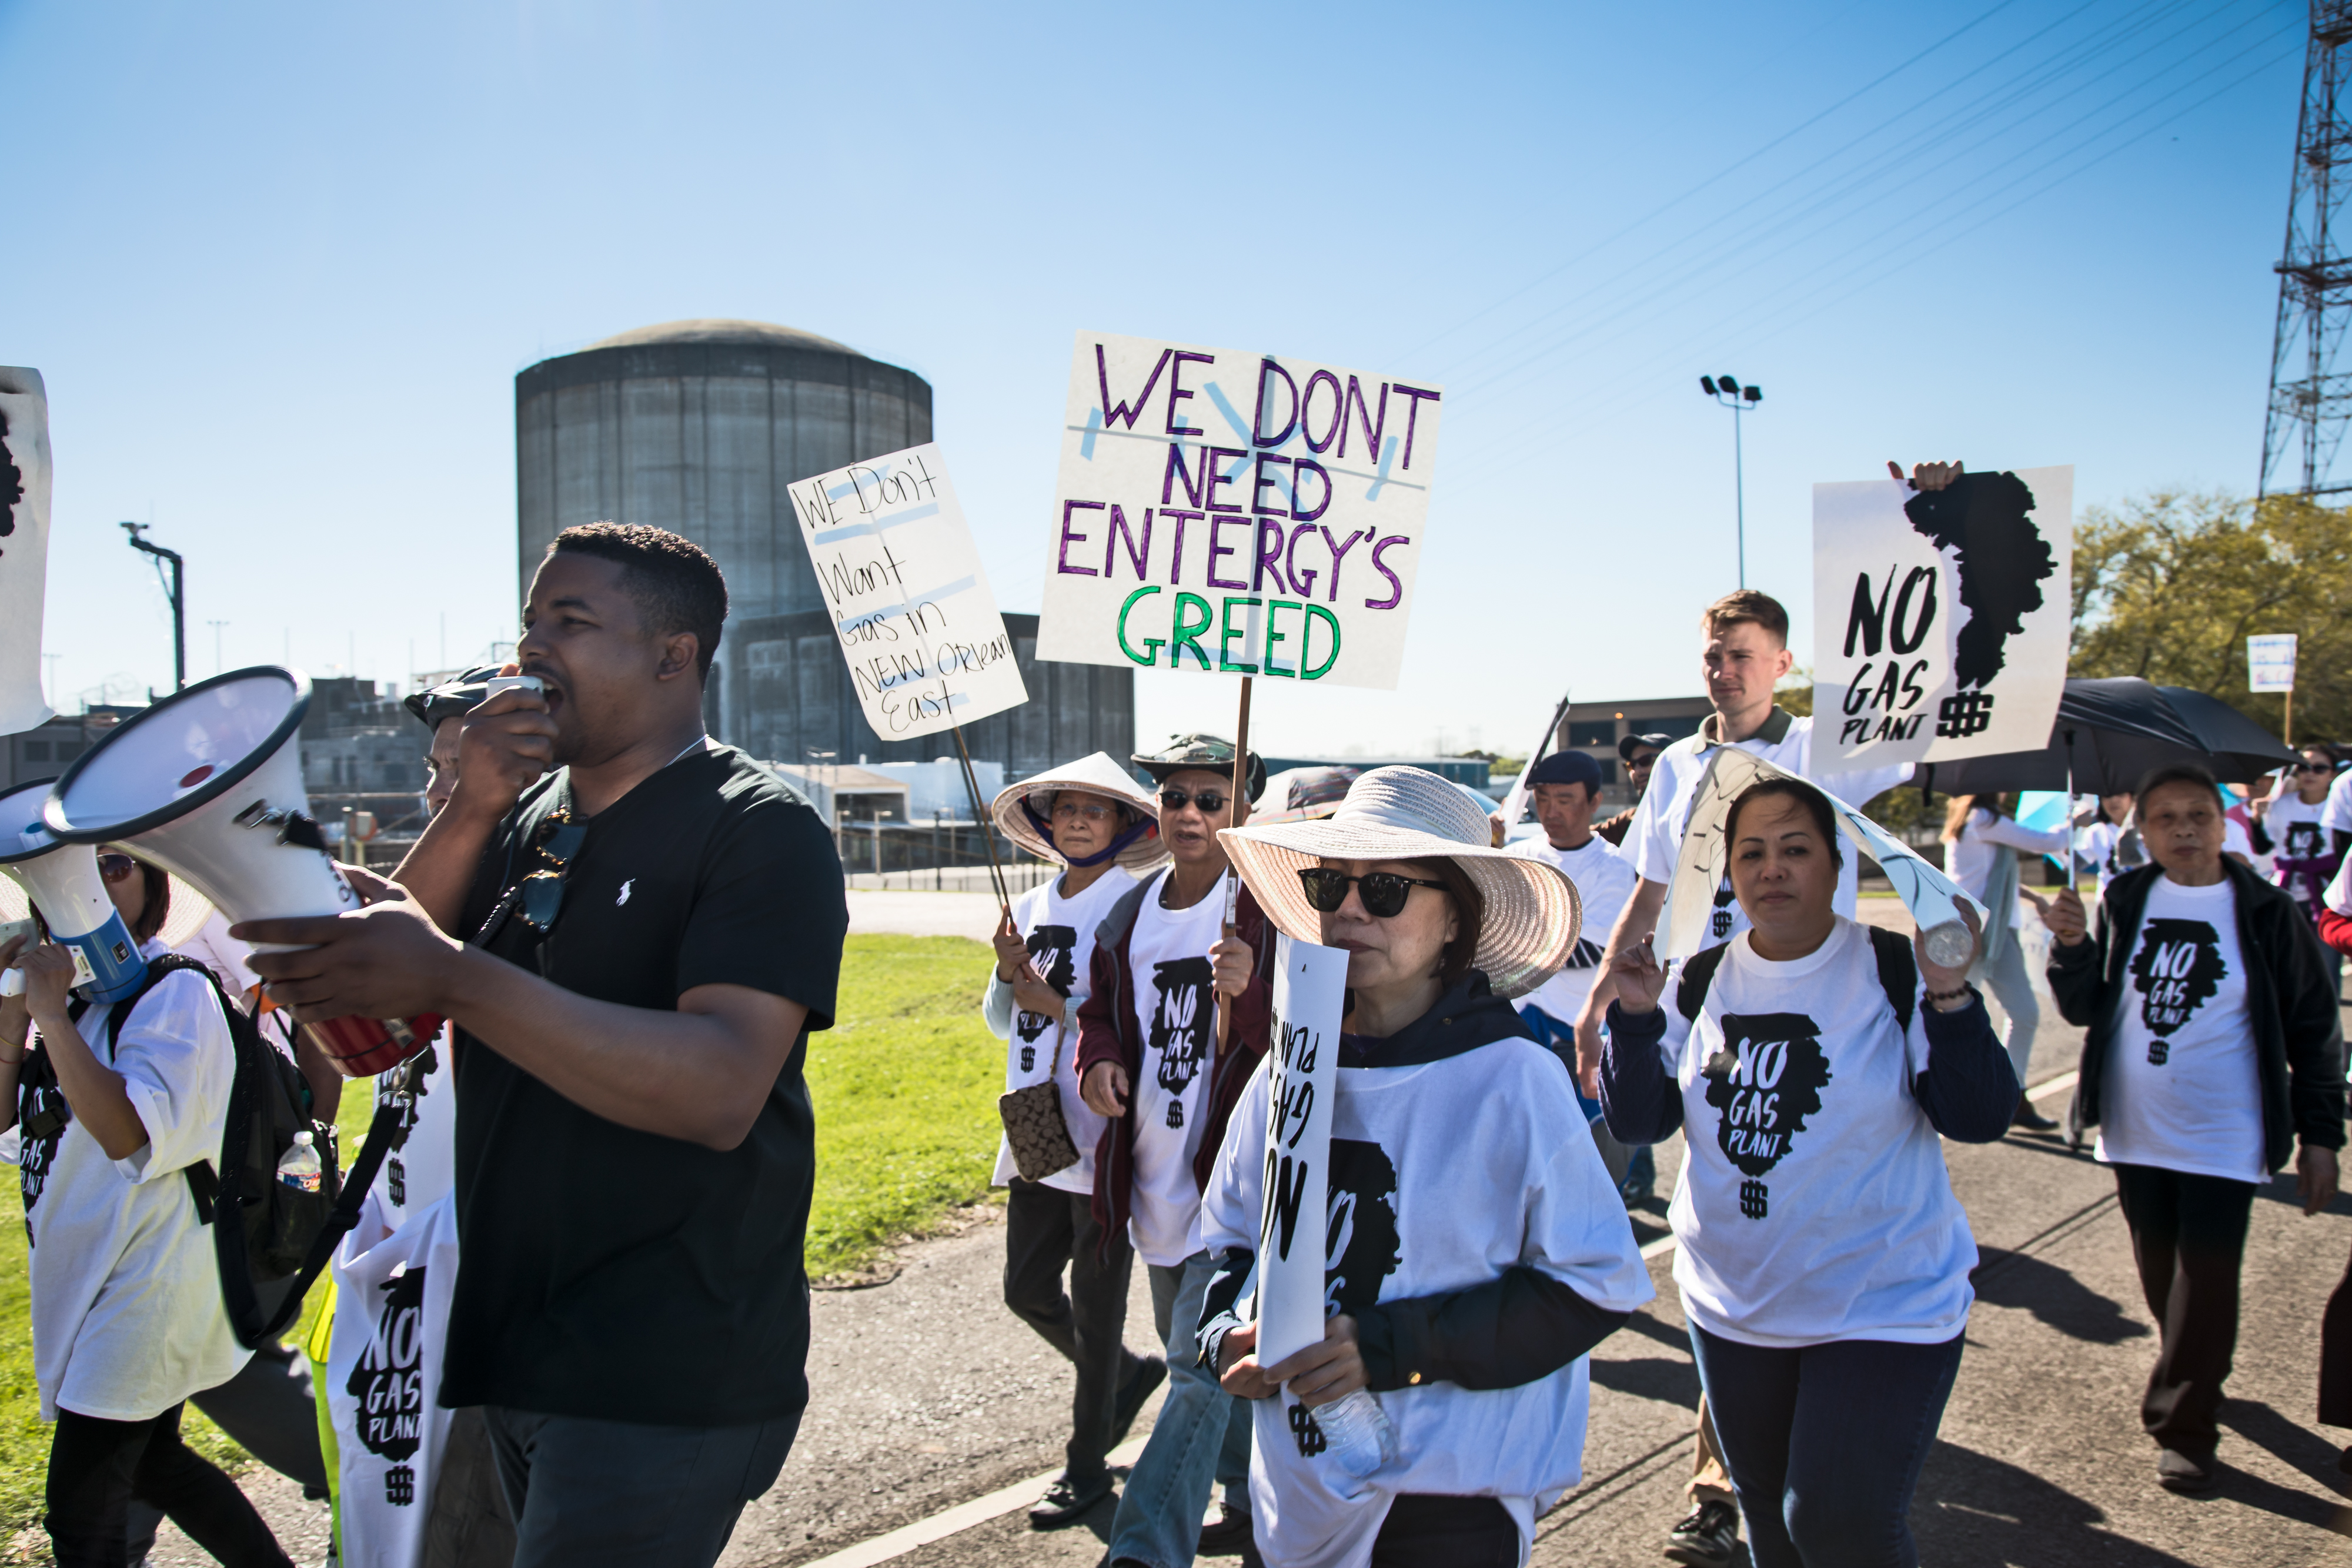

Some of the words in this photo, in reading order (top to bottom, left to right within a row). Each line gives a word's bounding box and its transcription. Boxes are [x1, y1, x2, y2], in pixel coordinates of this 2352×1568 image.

[1096, 344, 1214, 436] WE
[1253, 359, 1441, 470] DONT
[793, 477, 843, 529] WE
[848, 455, 937, 513] Don't
[1162, 443, 1332, 521] NEED
[818, 547, 906, 604] Want
[1058, 500, 1409, 609] ENTERGY'S
[837, 610, 898, 646] Gas
[1117, 586, 1341, 680] GREED
[1843, 564, 1937, 658] NO
[856, 649, 924, 700] NEW
[1842, 659, 1929, 716] GAS
[882, 680, 956, 732] East
[1840, 714, 1929, 745] PLANT
[2149, 940, 2198, 979] NO
[1164, 984, 1197, 1029] NO
[2147, 1006, 2186, 1025] PLANT
[2150, 979, 2189, 1006] GAS
[1165, 1029, 1194, 1059] GAS
[1728, 1037, 1789, 1089] NO
[1161, 1061, 1192, 1081] PLANT
[1269, 1073, 1314, 1149] GAS
[1729, 1089, 1779, 1129] GAS
[1728, 1129, 1783, 1158] PLANT
[1260, 1148, 1308, 1263] NO
[363, 1306, 421, 1371] NO
[366, 1370, 421, 1415] GAS
